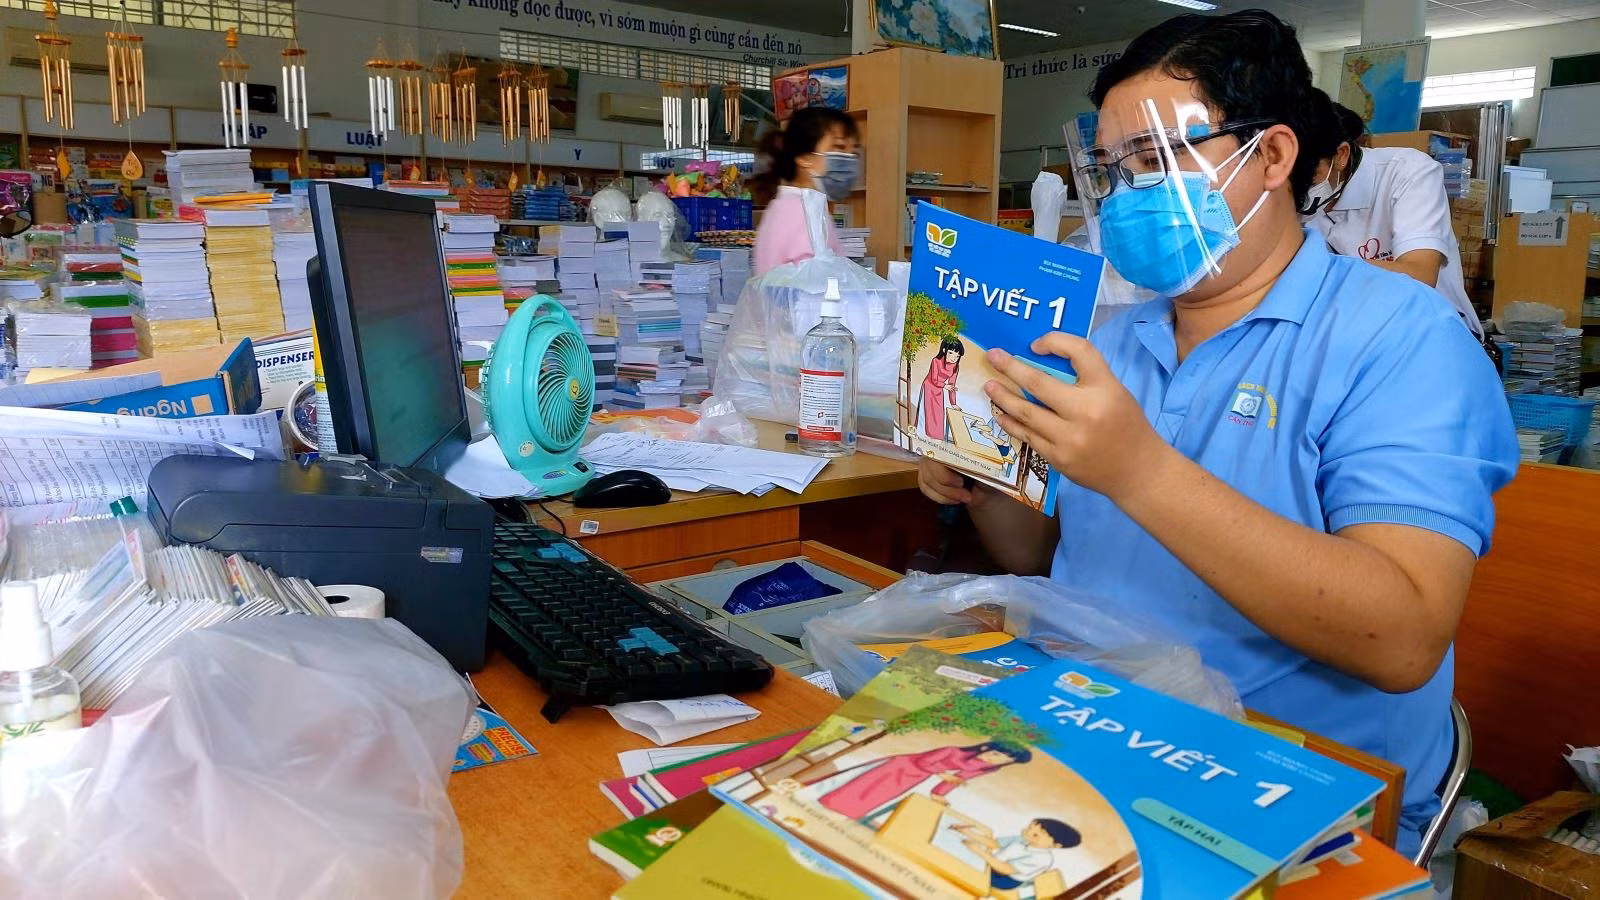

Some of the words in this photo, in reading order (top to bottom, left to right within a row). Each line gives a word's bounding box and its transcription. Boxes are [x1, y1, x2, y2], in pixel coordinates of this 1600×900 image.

[523, 1, 550, 21] đọc
[599, 9, 613, 27] vì
[617, 11, 645, 31] sớm
[649, 18, 686, 42] muộn
[763, 33, 784, 53] đến
[788, 39, 802, 55] nó
[1004, 63, 1026, 79] Tri
[1032, 57, 1067, 76] thức
[1072, 54, 1087, 70] là
[574, 149, 582, 161] Y
[934, 266, 979, 299] TẬP
[982, 283, 1040, 320] VIẾT
[1048, 296, 1066, 329] 1
[1040, 695, 1126, 733] TẬP
[1127, 730, 1239, 781] VIẾT
[1253, 781, 1294, 808] 1
[1194, 830, 1222, 845] HAI
